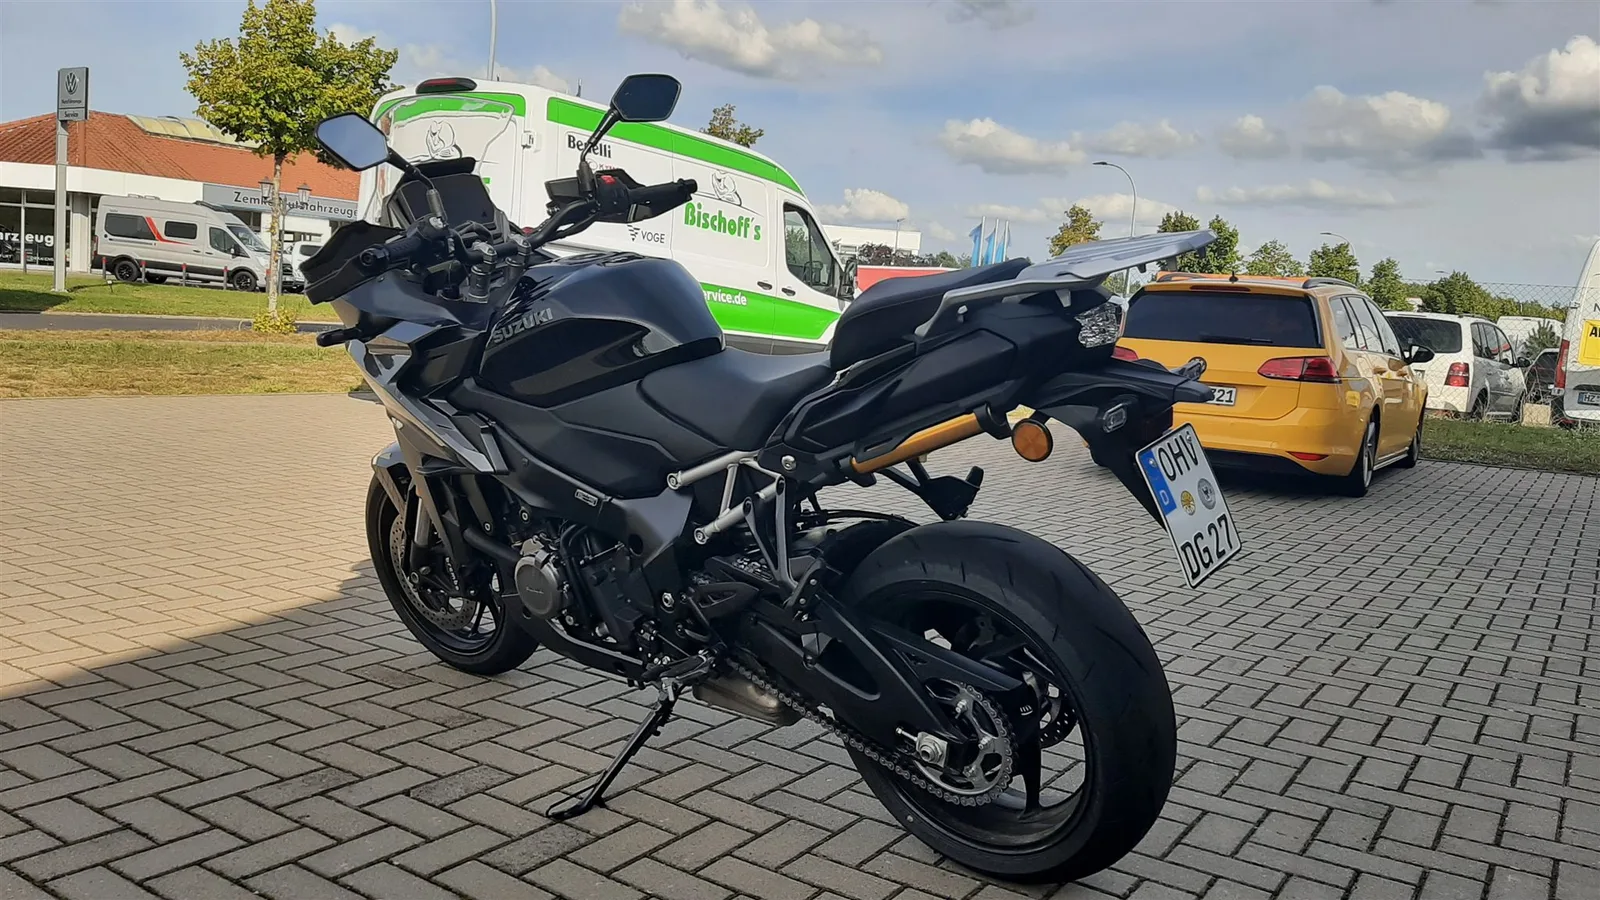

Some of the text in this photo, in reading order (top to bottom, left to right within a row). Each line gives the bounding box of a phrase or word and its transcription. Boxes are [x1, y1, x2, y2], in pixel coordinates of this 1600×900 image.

[641, 230, 666, 244] VOGE
[492, 307, 554, 343] SUZUKI
[1589, 326, 1600, 338] A
[1157, 430, 1199, 481] OHV
[1159, 489, 1169, 506] D
